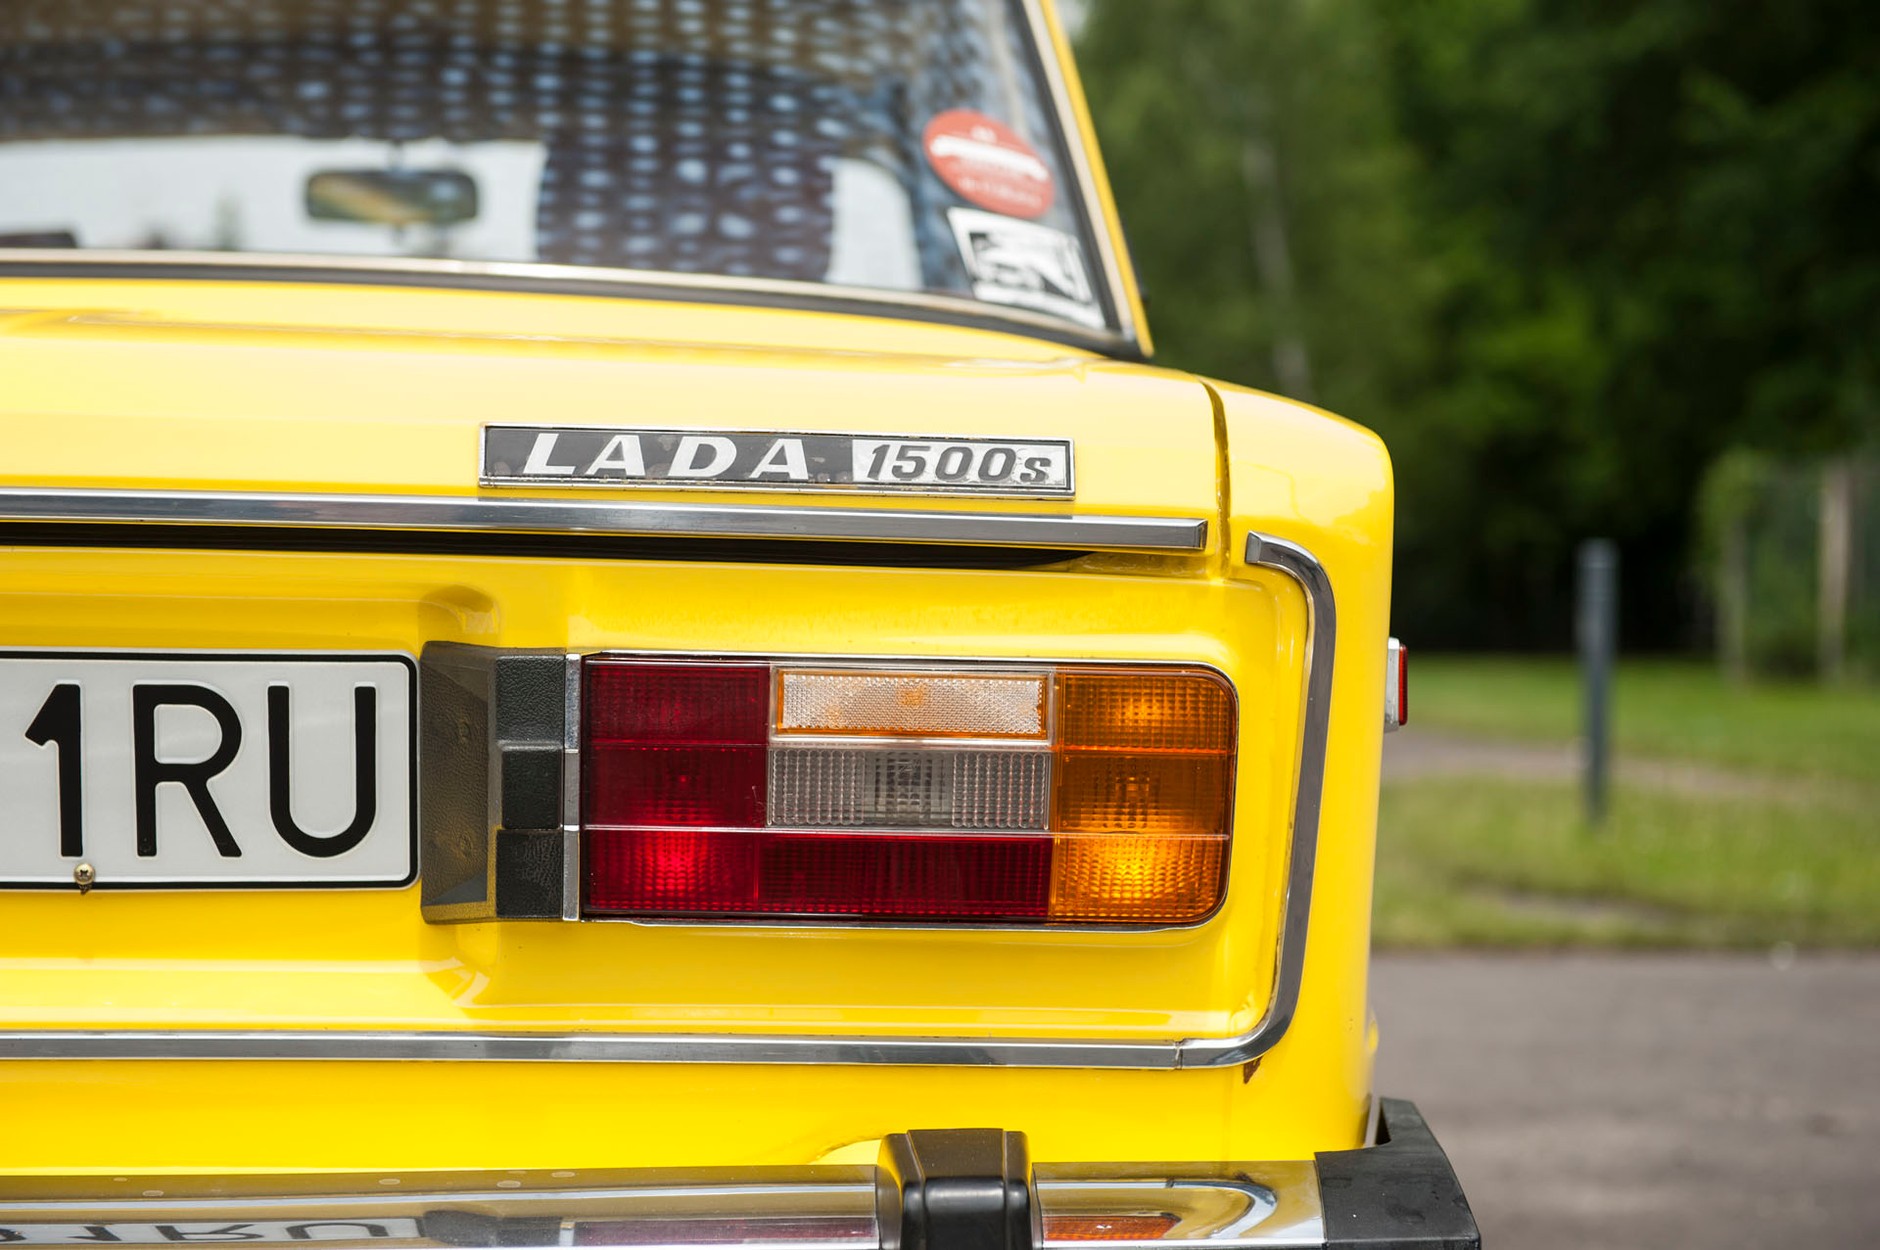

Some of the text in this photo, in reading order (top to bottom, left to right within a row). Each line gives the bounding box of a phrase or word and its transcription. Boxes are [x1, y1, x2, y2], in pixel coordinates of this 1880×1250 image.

[523, 433, 1052, 483] LADA 1500s
[25, 683, 377, 858] 1RU
